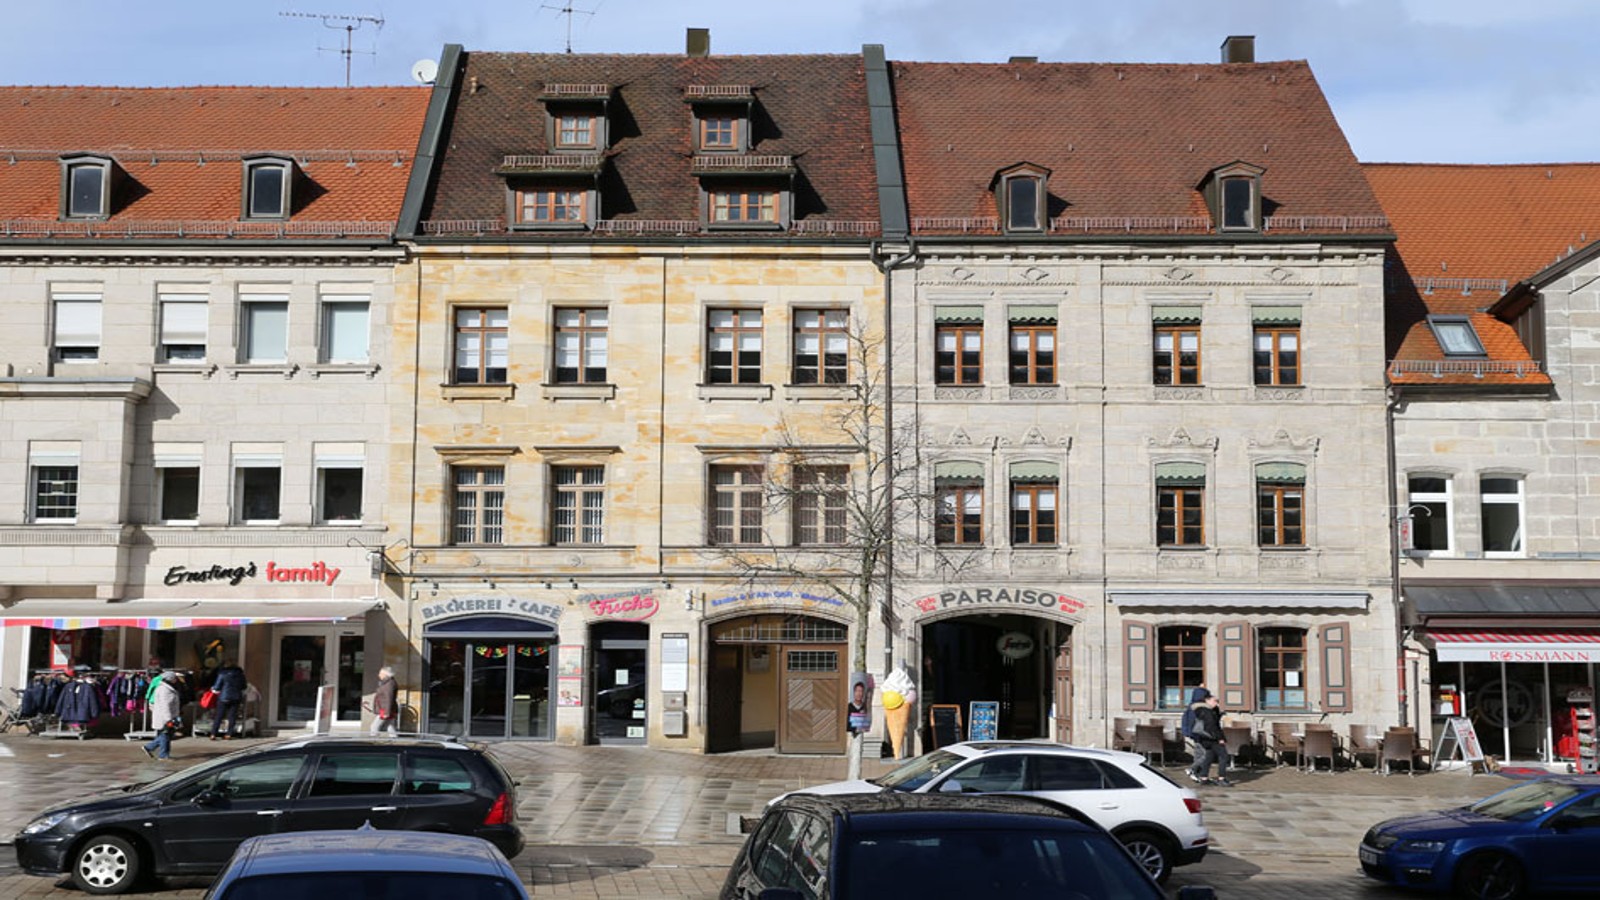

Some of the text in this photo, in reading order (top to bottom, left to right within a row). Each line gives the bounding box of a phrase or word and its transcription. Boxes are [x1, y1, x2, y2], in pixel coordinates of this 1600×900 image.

[164, 560, 341, 586] Ernsting's family
[589, 594, 655, 617] Fuchs
[941, 588, 1056, 608] PARAISO
[1489, 651, 1590, 662] ROSSMANN
